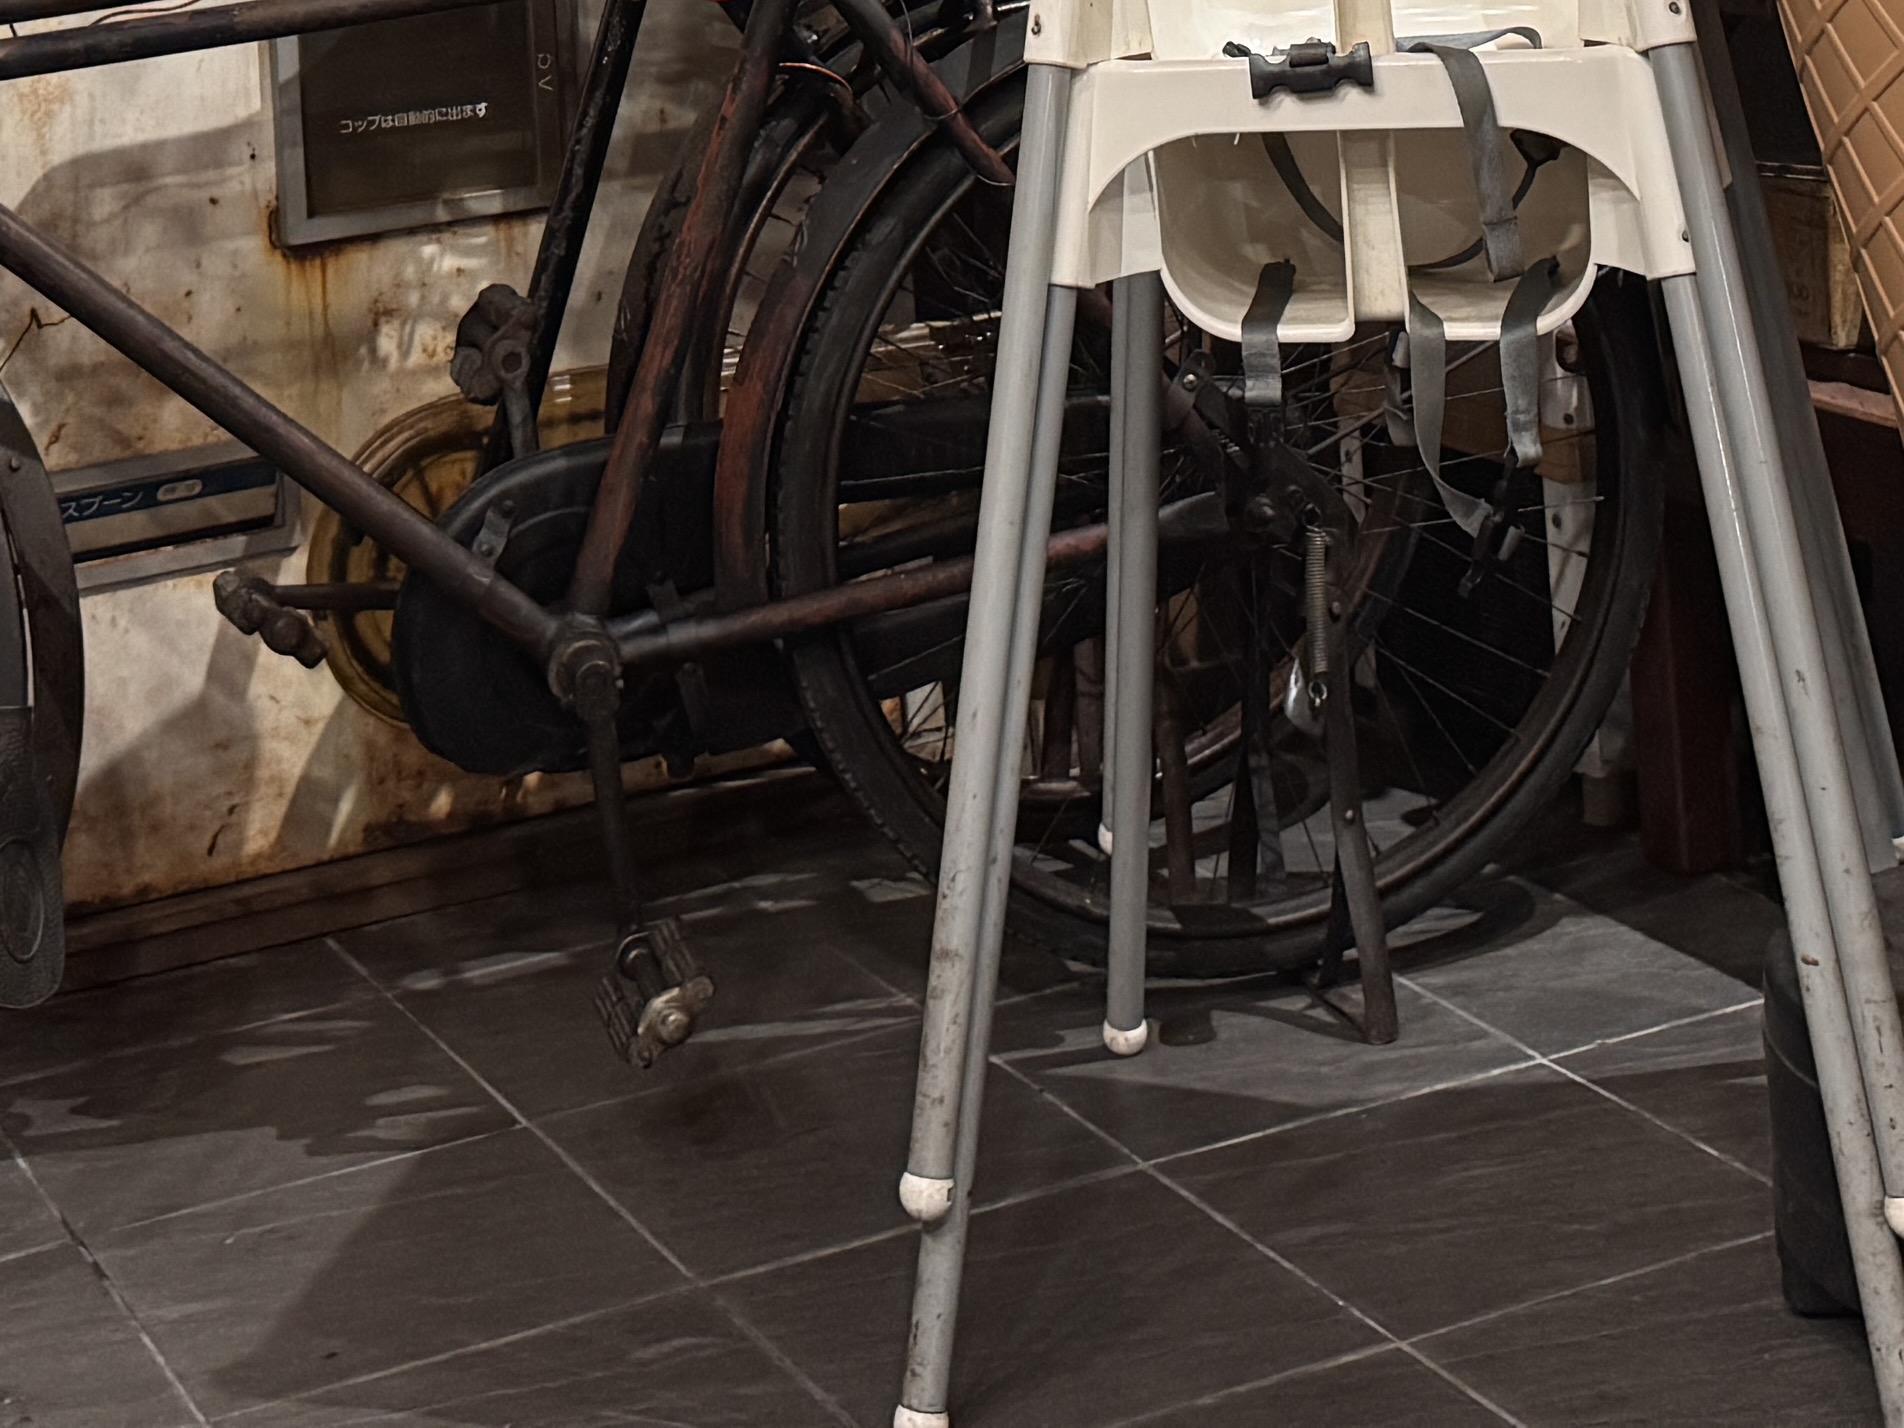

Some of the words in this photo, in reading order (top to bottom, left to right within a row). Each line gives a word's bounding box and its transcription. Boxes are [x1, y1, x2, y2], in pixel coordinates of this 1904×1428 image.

[340, 102, 488, 133] コップは自動的に出ます
